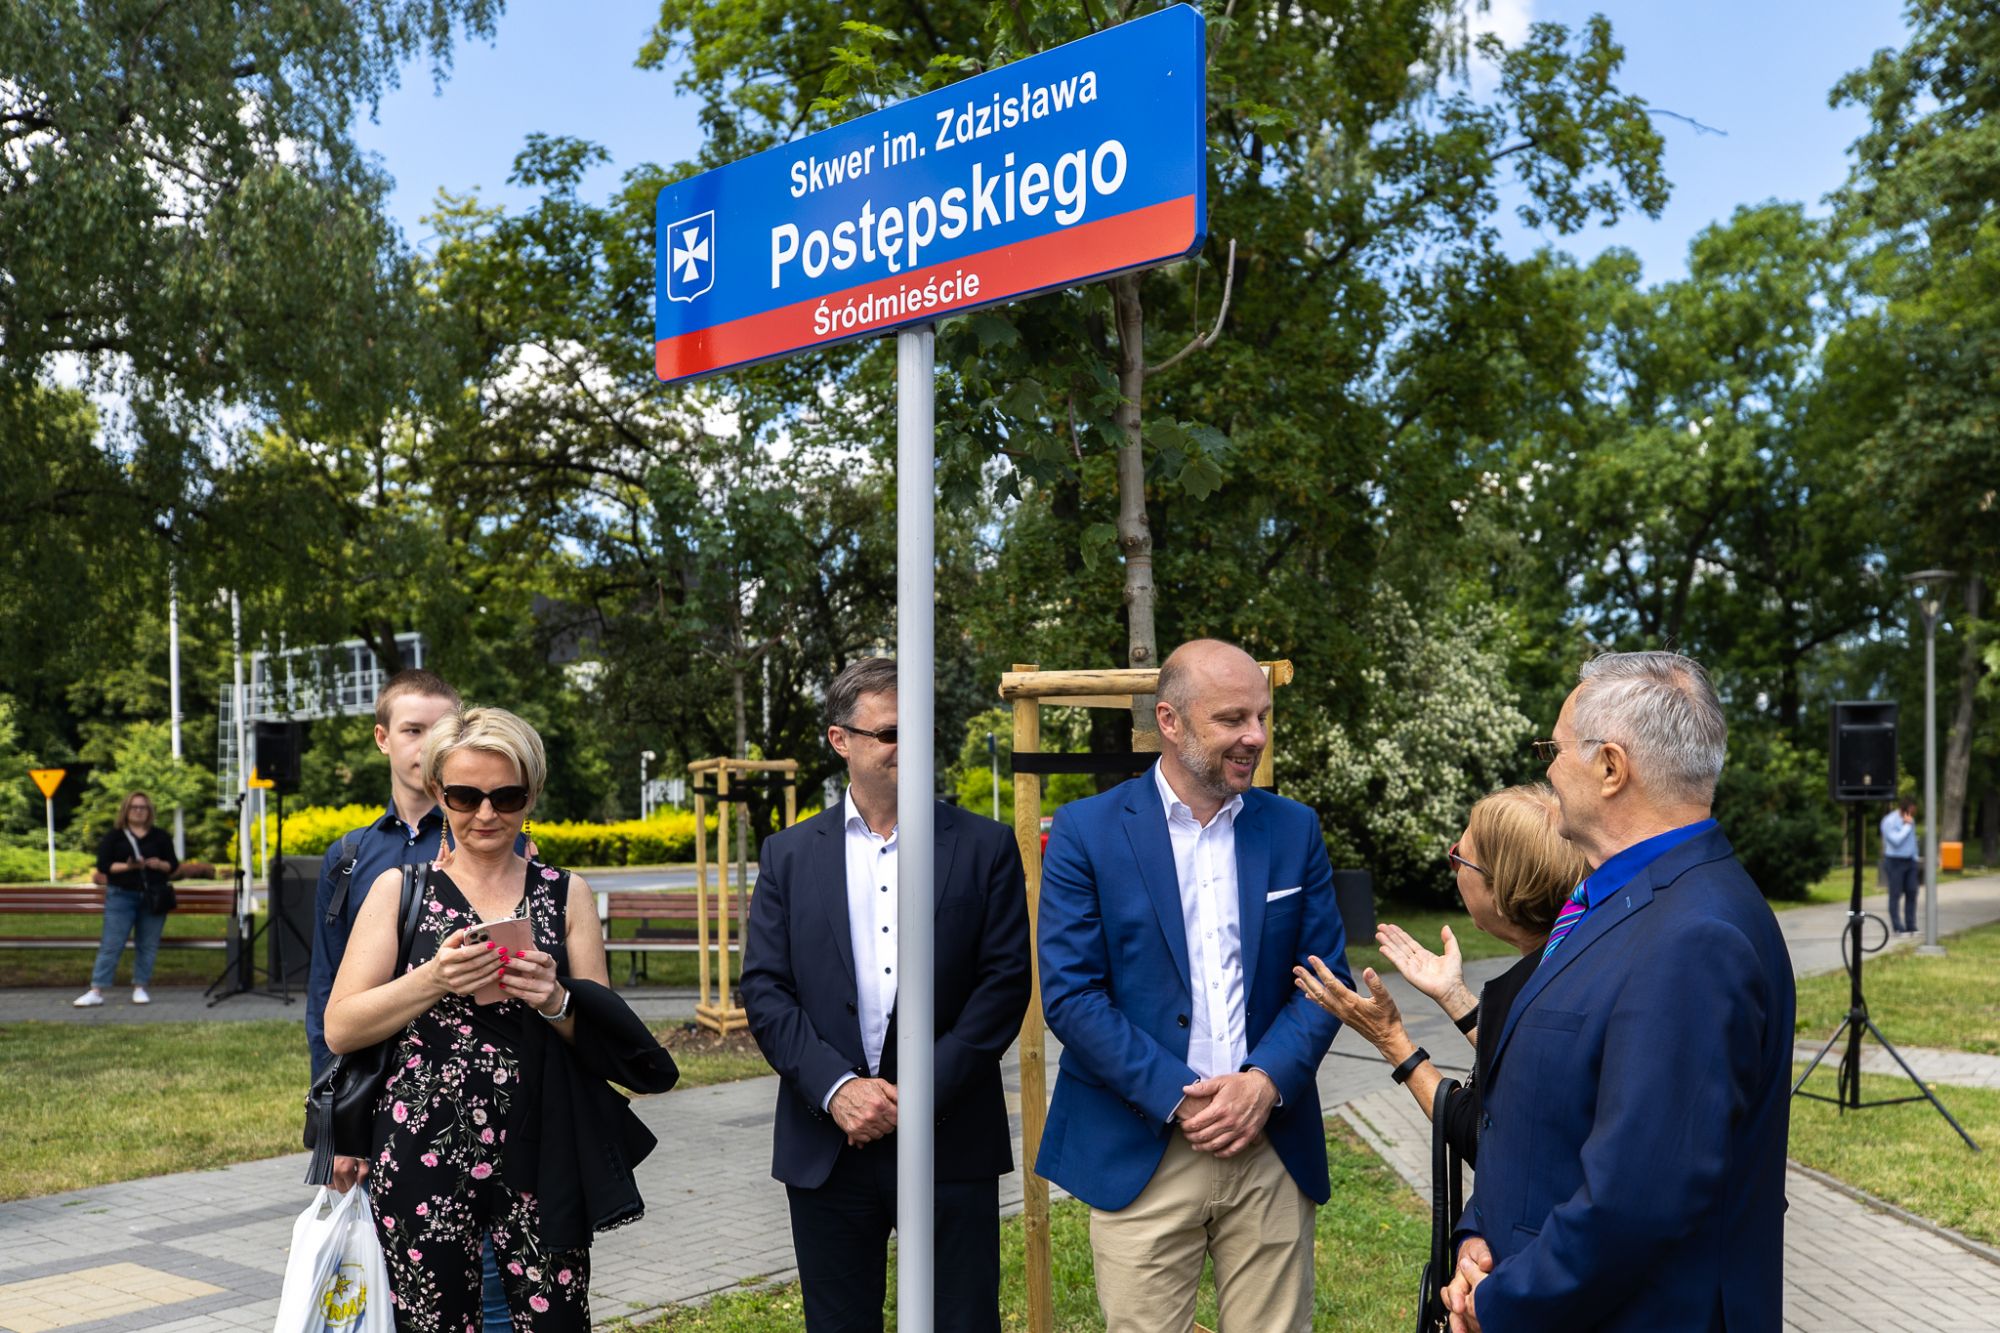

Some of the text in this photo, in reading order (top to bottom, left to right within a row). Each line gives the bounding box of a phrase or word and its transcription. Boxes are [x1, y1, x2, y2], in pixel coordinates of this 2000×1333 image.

[790, 70, 1098, 198] Skwer im. Zdzisława
[770, 139, 1127, 289] Postępskiego
[813, 269, 980, 336] Śródmieście
